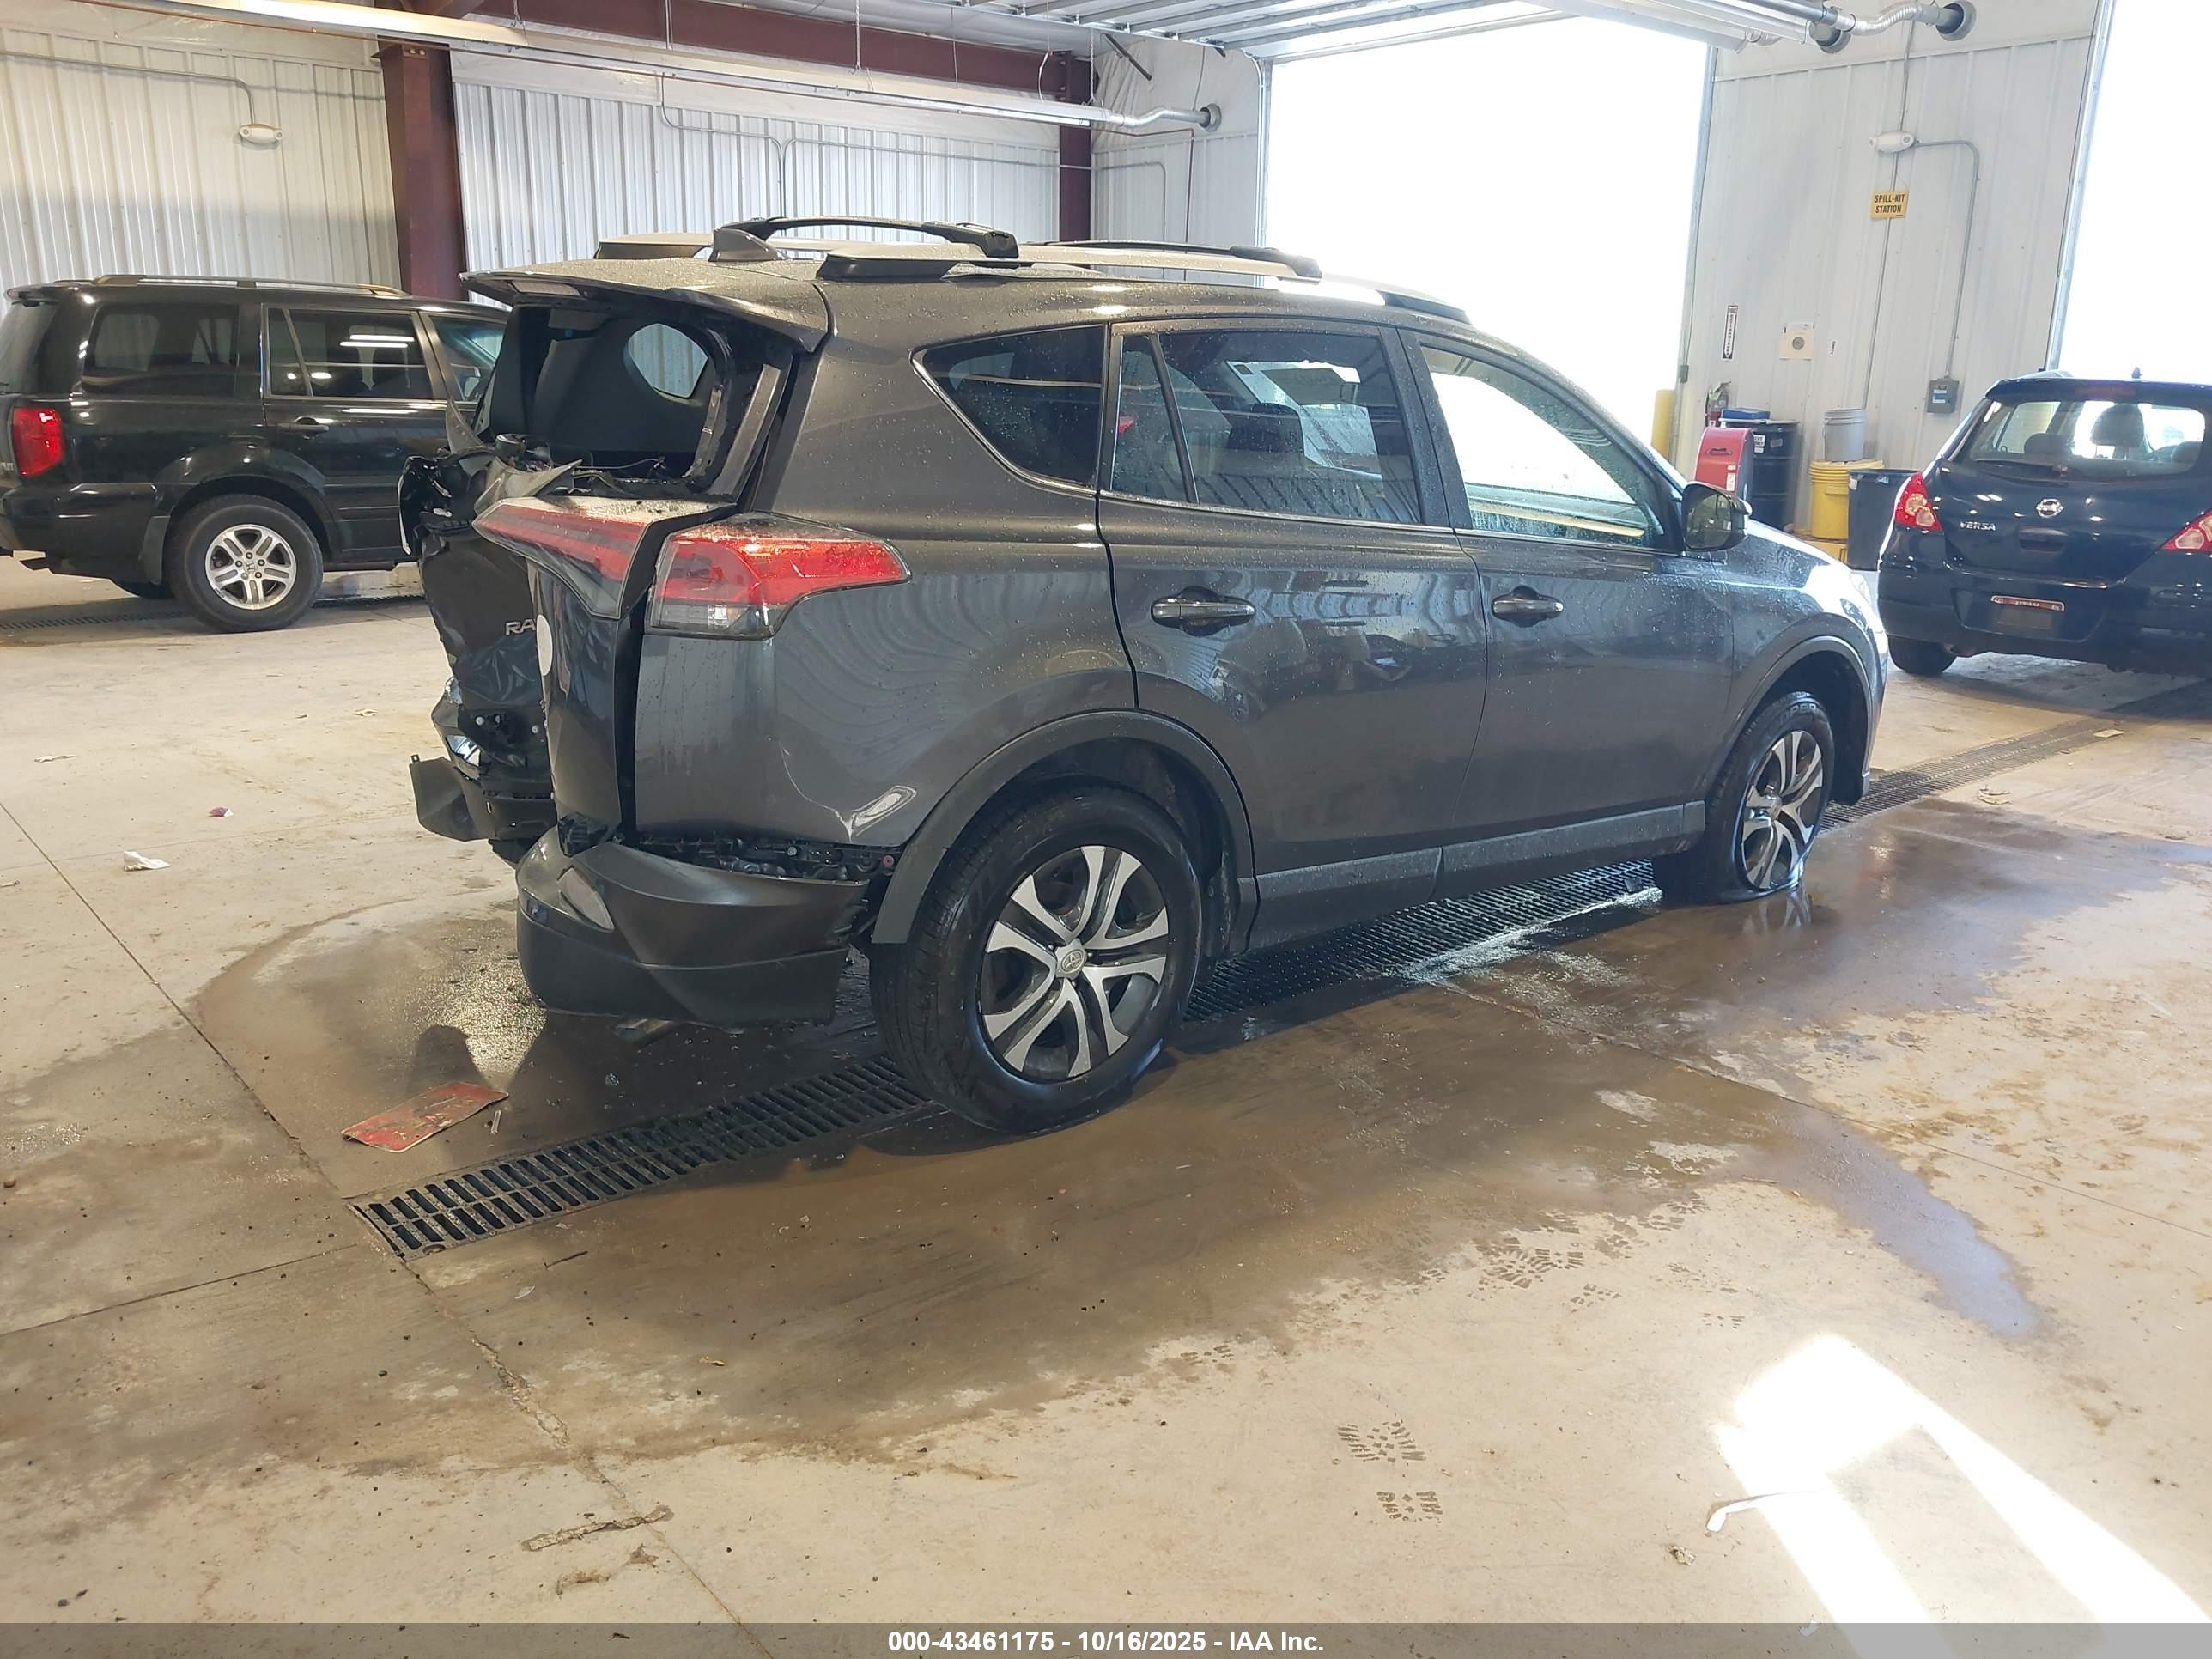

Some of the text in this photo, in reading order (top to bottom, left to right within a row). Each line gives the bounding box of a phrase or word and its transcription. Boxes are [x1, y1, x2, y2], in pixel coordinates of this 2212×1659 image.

[1875, 194, 1905, 203] SPILL-KIT
[1959, 521, 1996, 532] VERSA
[505, 618, 537, 635] RA
